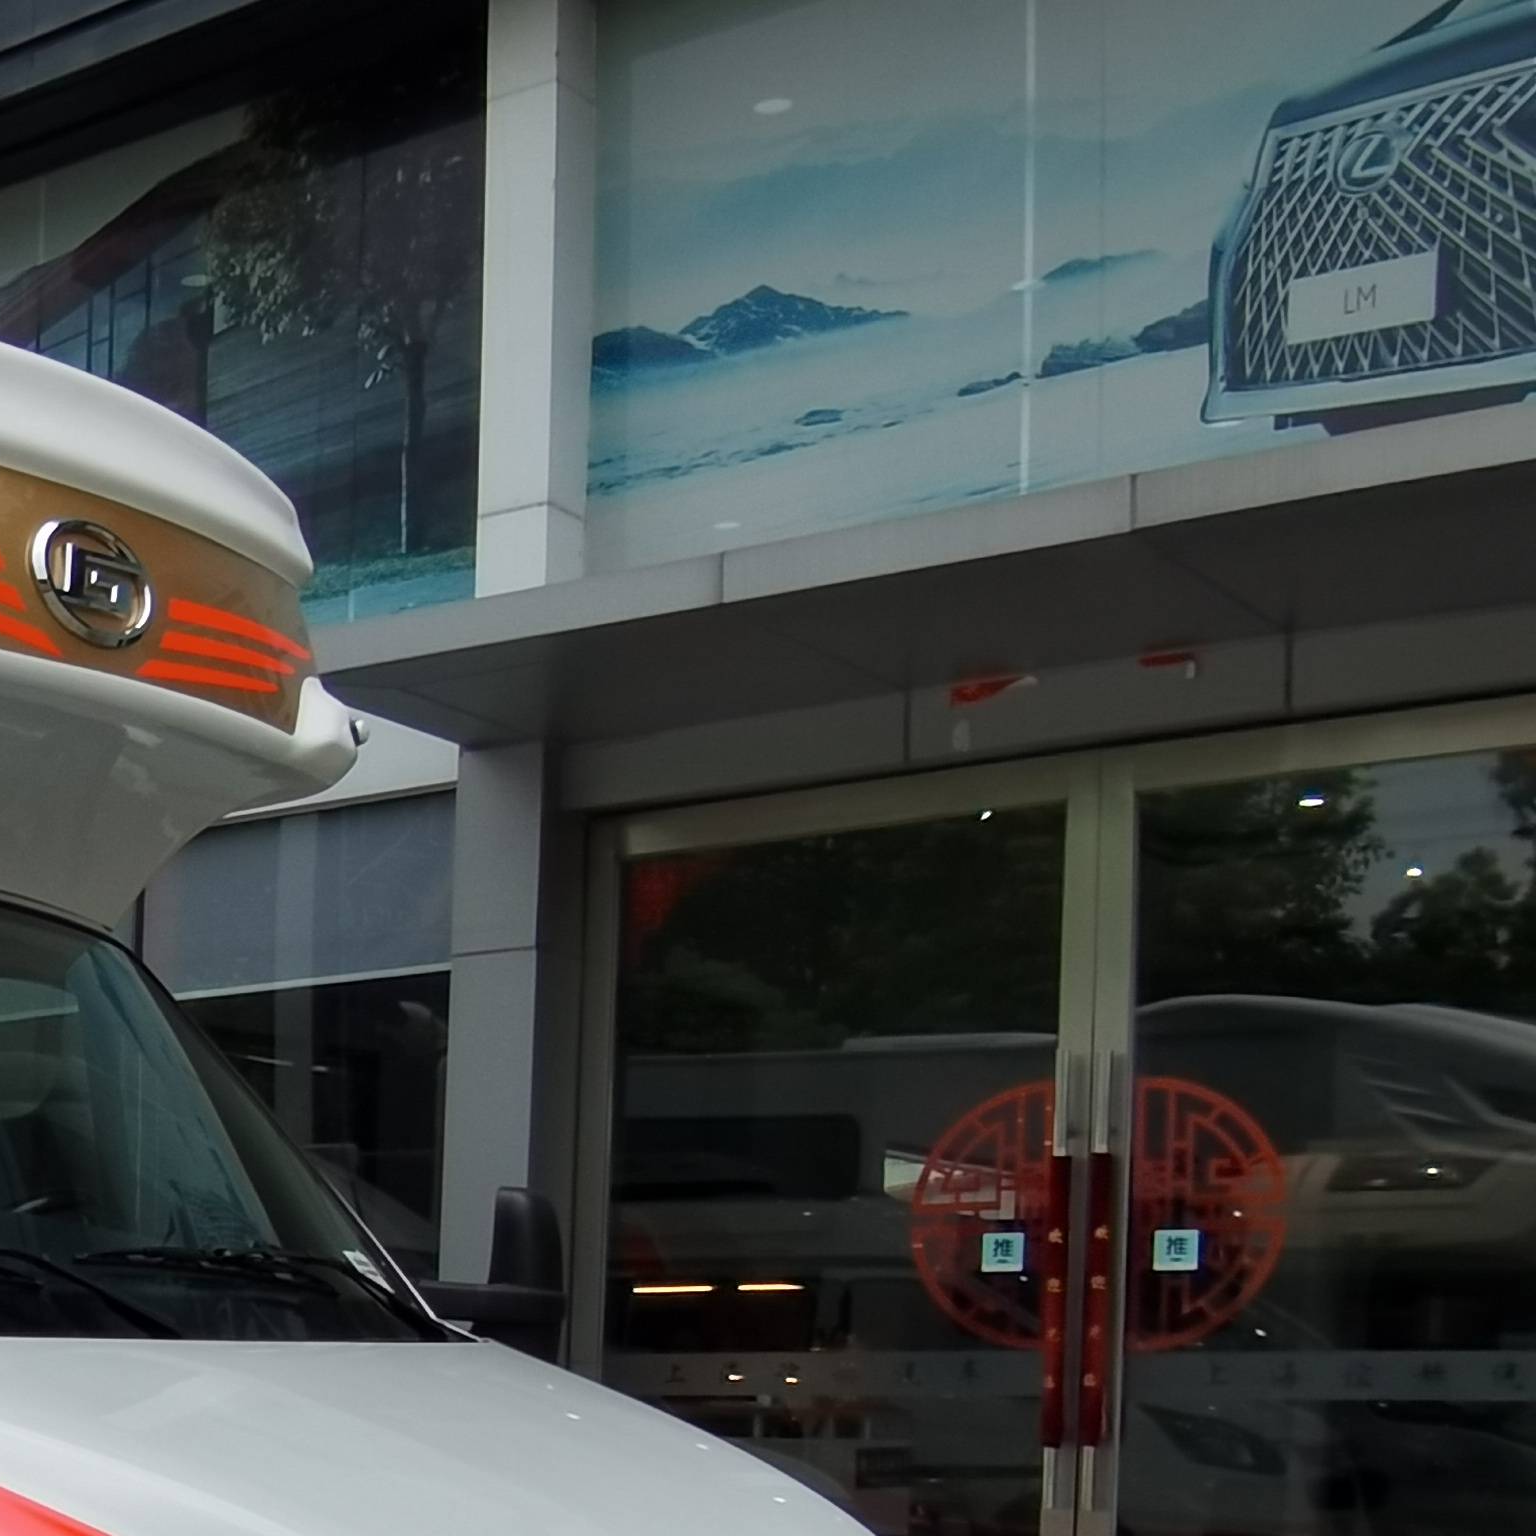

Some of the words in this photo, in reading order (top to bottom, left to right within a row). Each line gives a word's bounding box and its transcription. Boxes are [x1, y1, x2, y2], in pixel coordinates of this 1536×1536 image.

[1343, 283, 1377, 315] LM
[992, 1238, 1014, 1257] 推
[1165, 1235, 1188, 1256] 推
